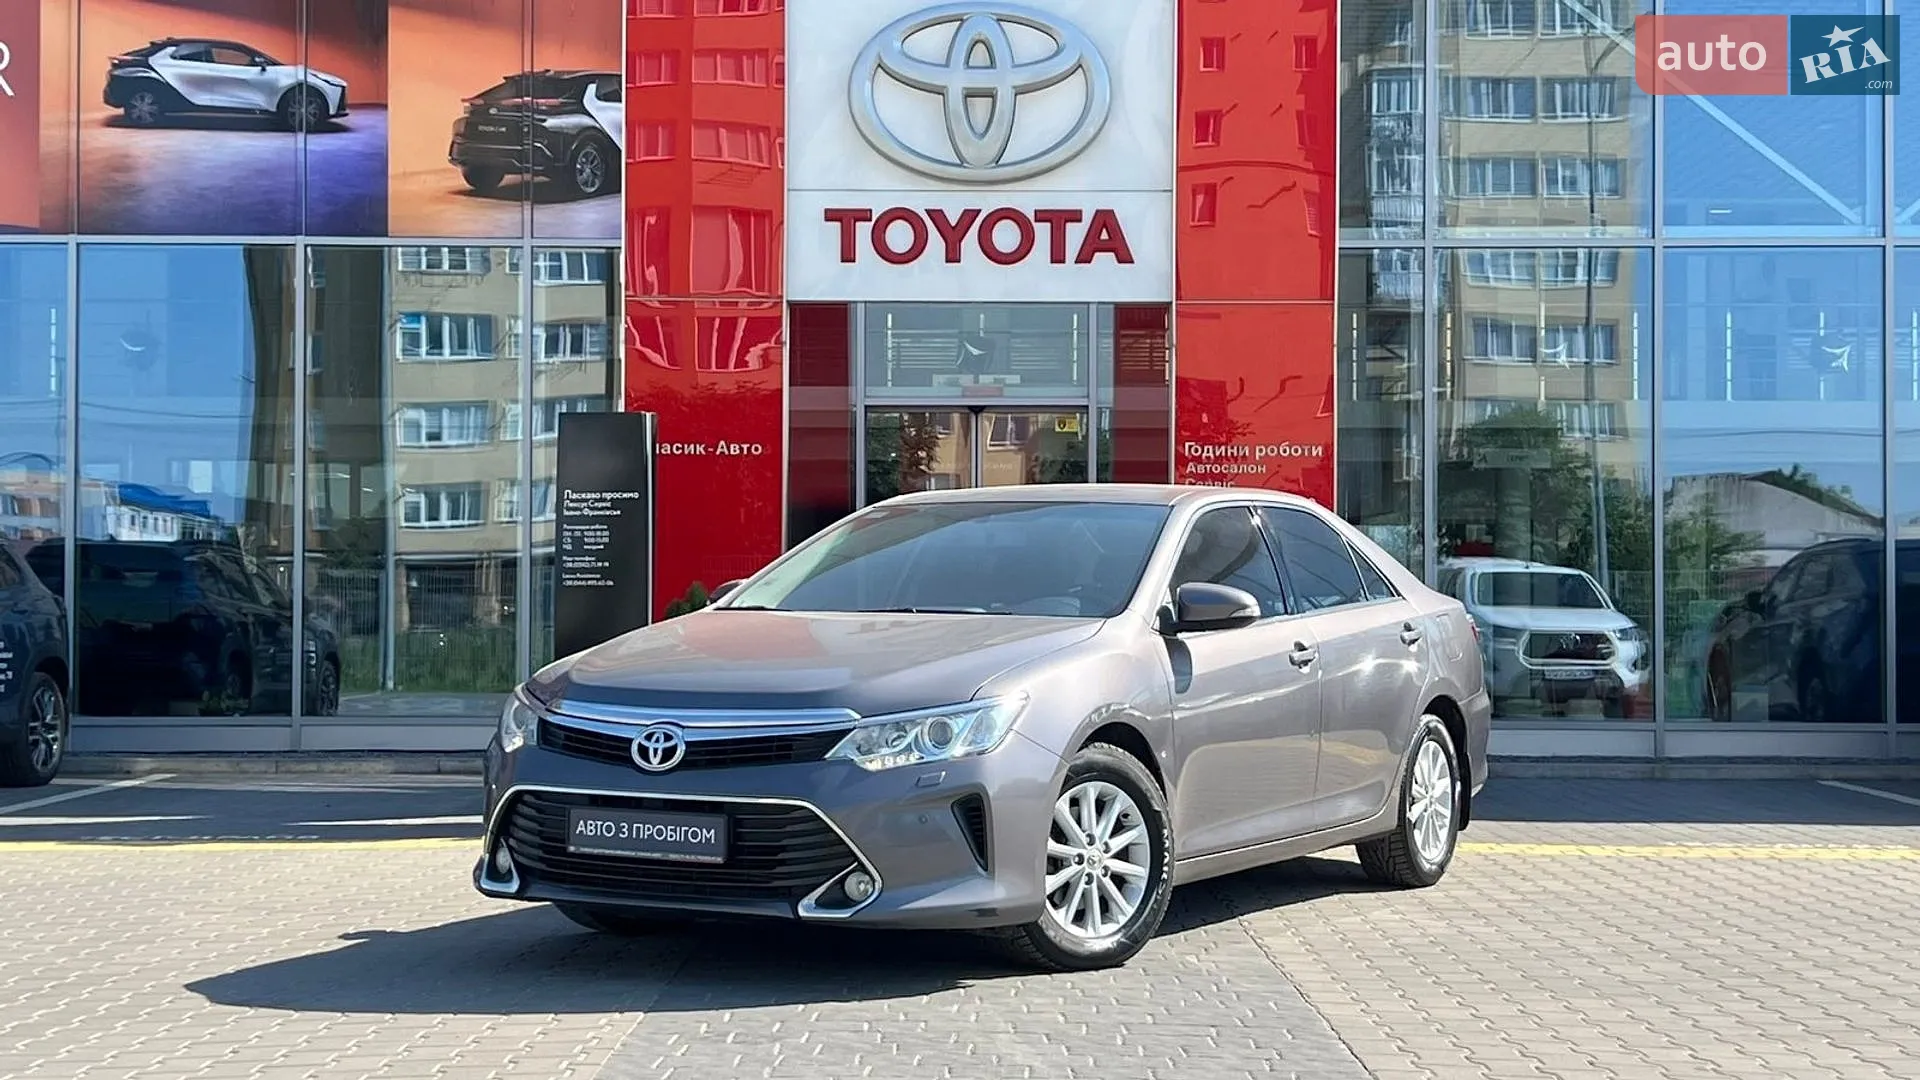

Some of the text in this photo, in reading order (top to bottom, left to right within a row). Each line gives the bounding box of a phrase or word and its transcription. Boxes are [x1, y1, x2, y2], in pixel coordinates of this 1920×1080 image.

[824, 207, 1135, 265] TOYOTA
[1184, 441, 1322, 459] Години роботи
[1186, 462, 1266, 474] Автосалон
[576, 820, 716, 843] АВТО З ПРОБІГОМ
